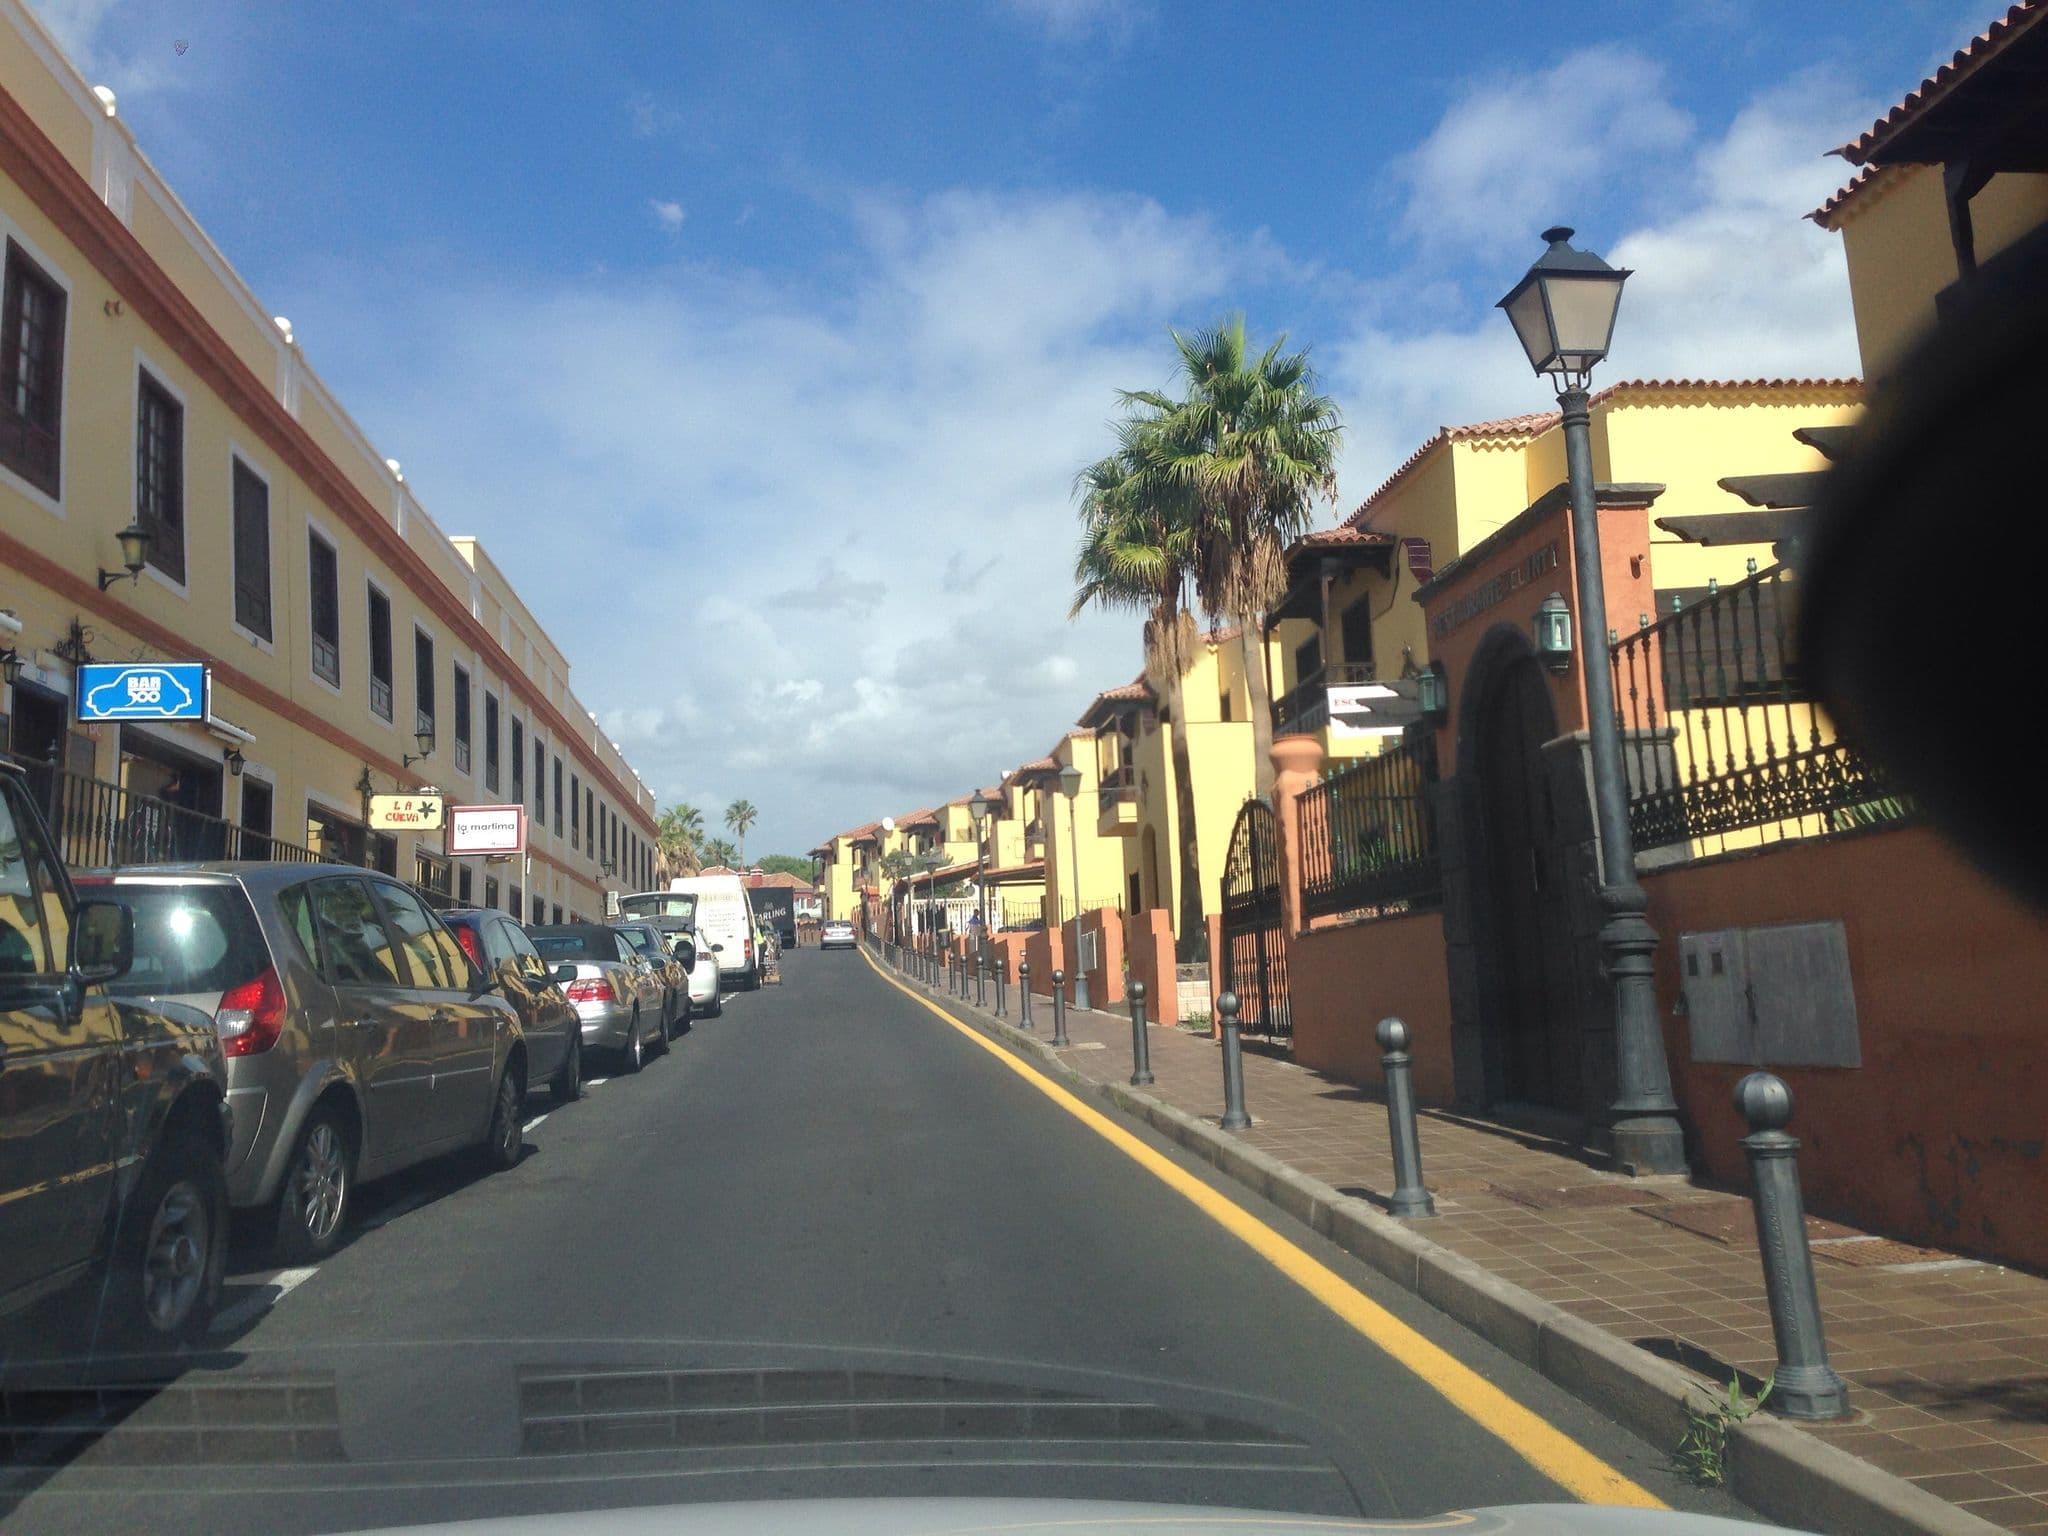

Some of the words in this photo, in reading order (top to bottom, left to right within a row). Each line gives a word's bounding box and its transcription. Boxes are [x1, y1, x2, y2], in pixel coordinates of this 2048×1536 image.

[127, 676, 161, 688] BAR
[124, 688, 161, 707] 500
[385, 812, 419, 822] CUEVA
